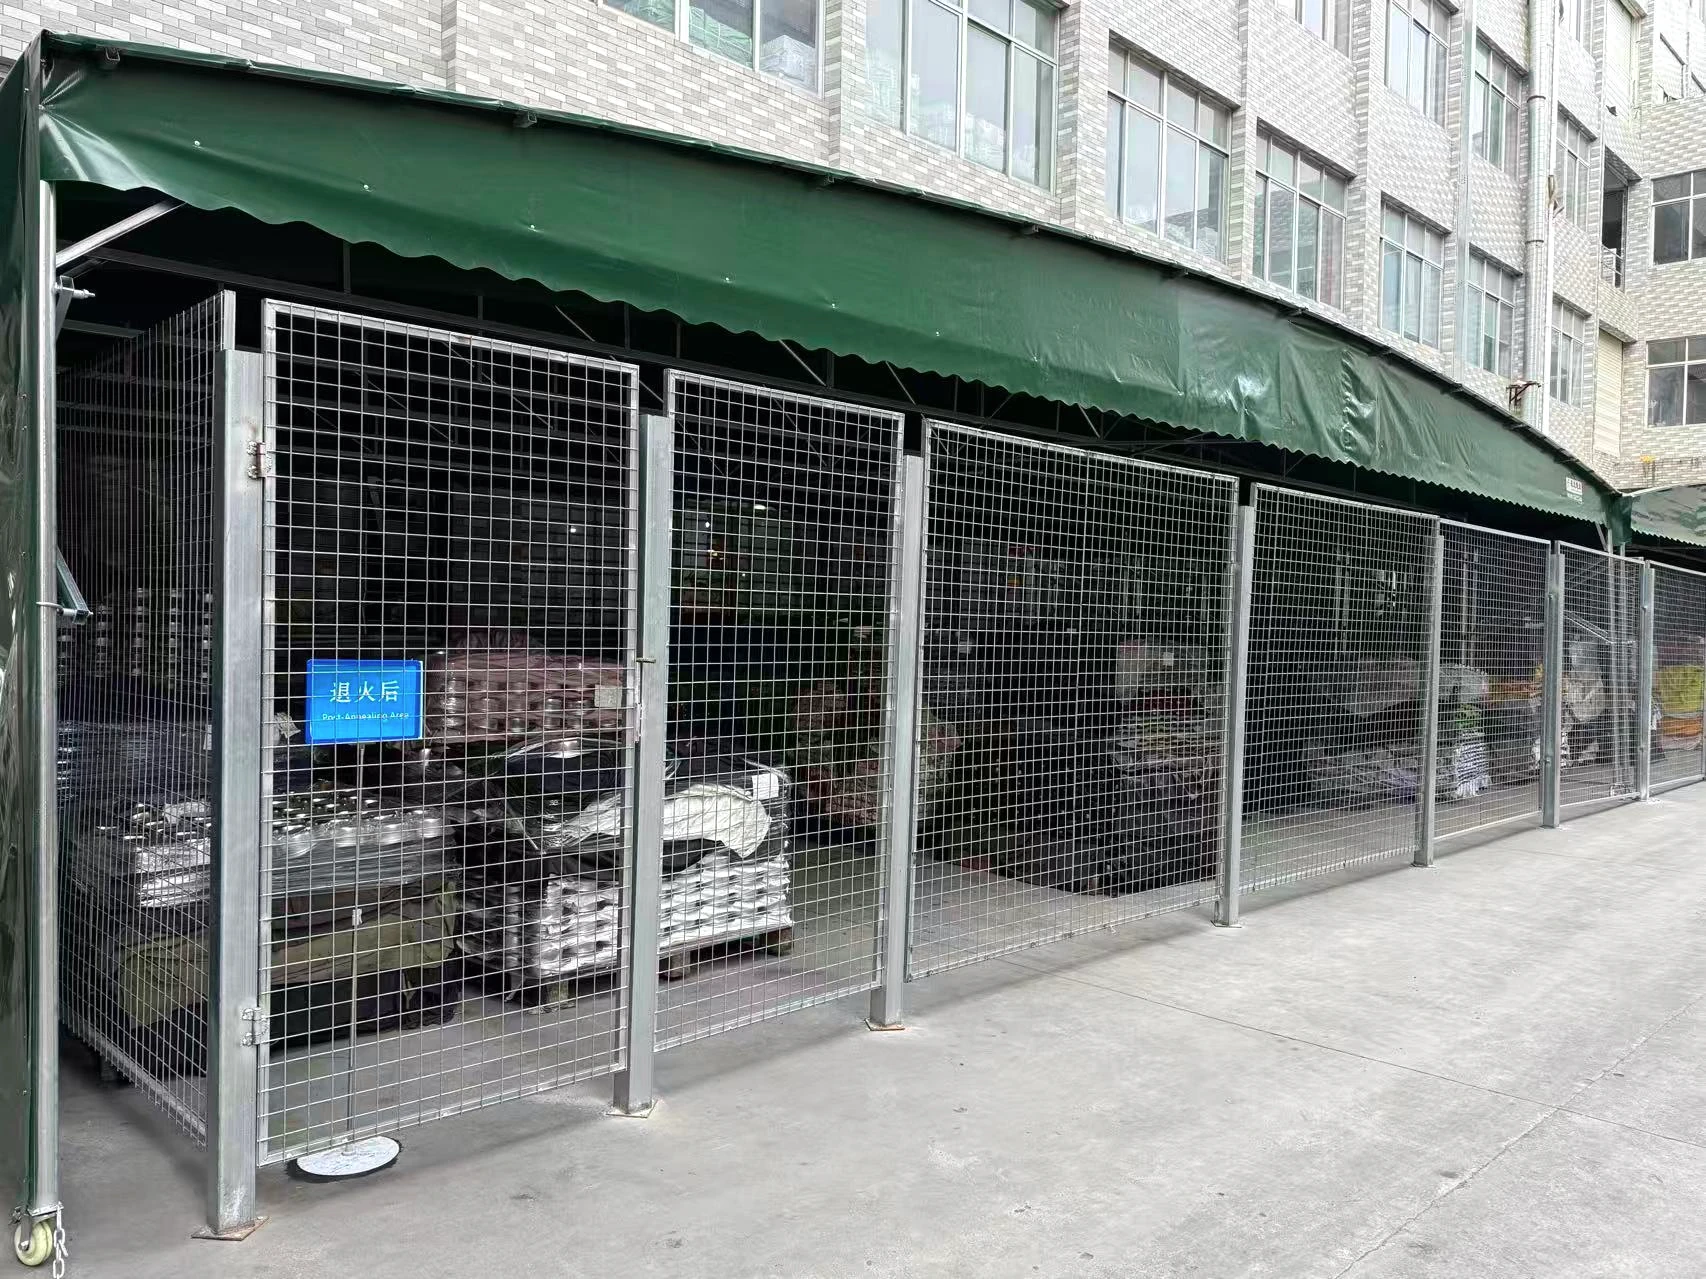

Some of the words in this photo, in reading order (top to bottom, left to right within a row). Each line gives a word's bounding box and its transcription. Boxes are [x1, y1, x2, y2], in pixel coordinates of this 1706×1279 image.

[329, 680, 399, 703] 退火后
[390, 711, 409, 719] Area
